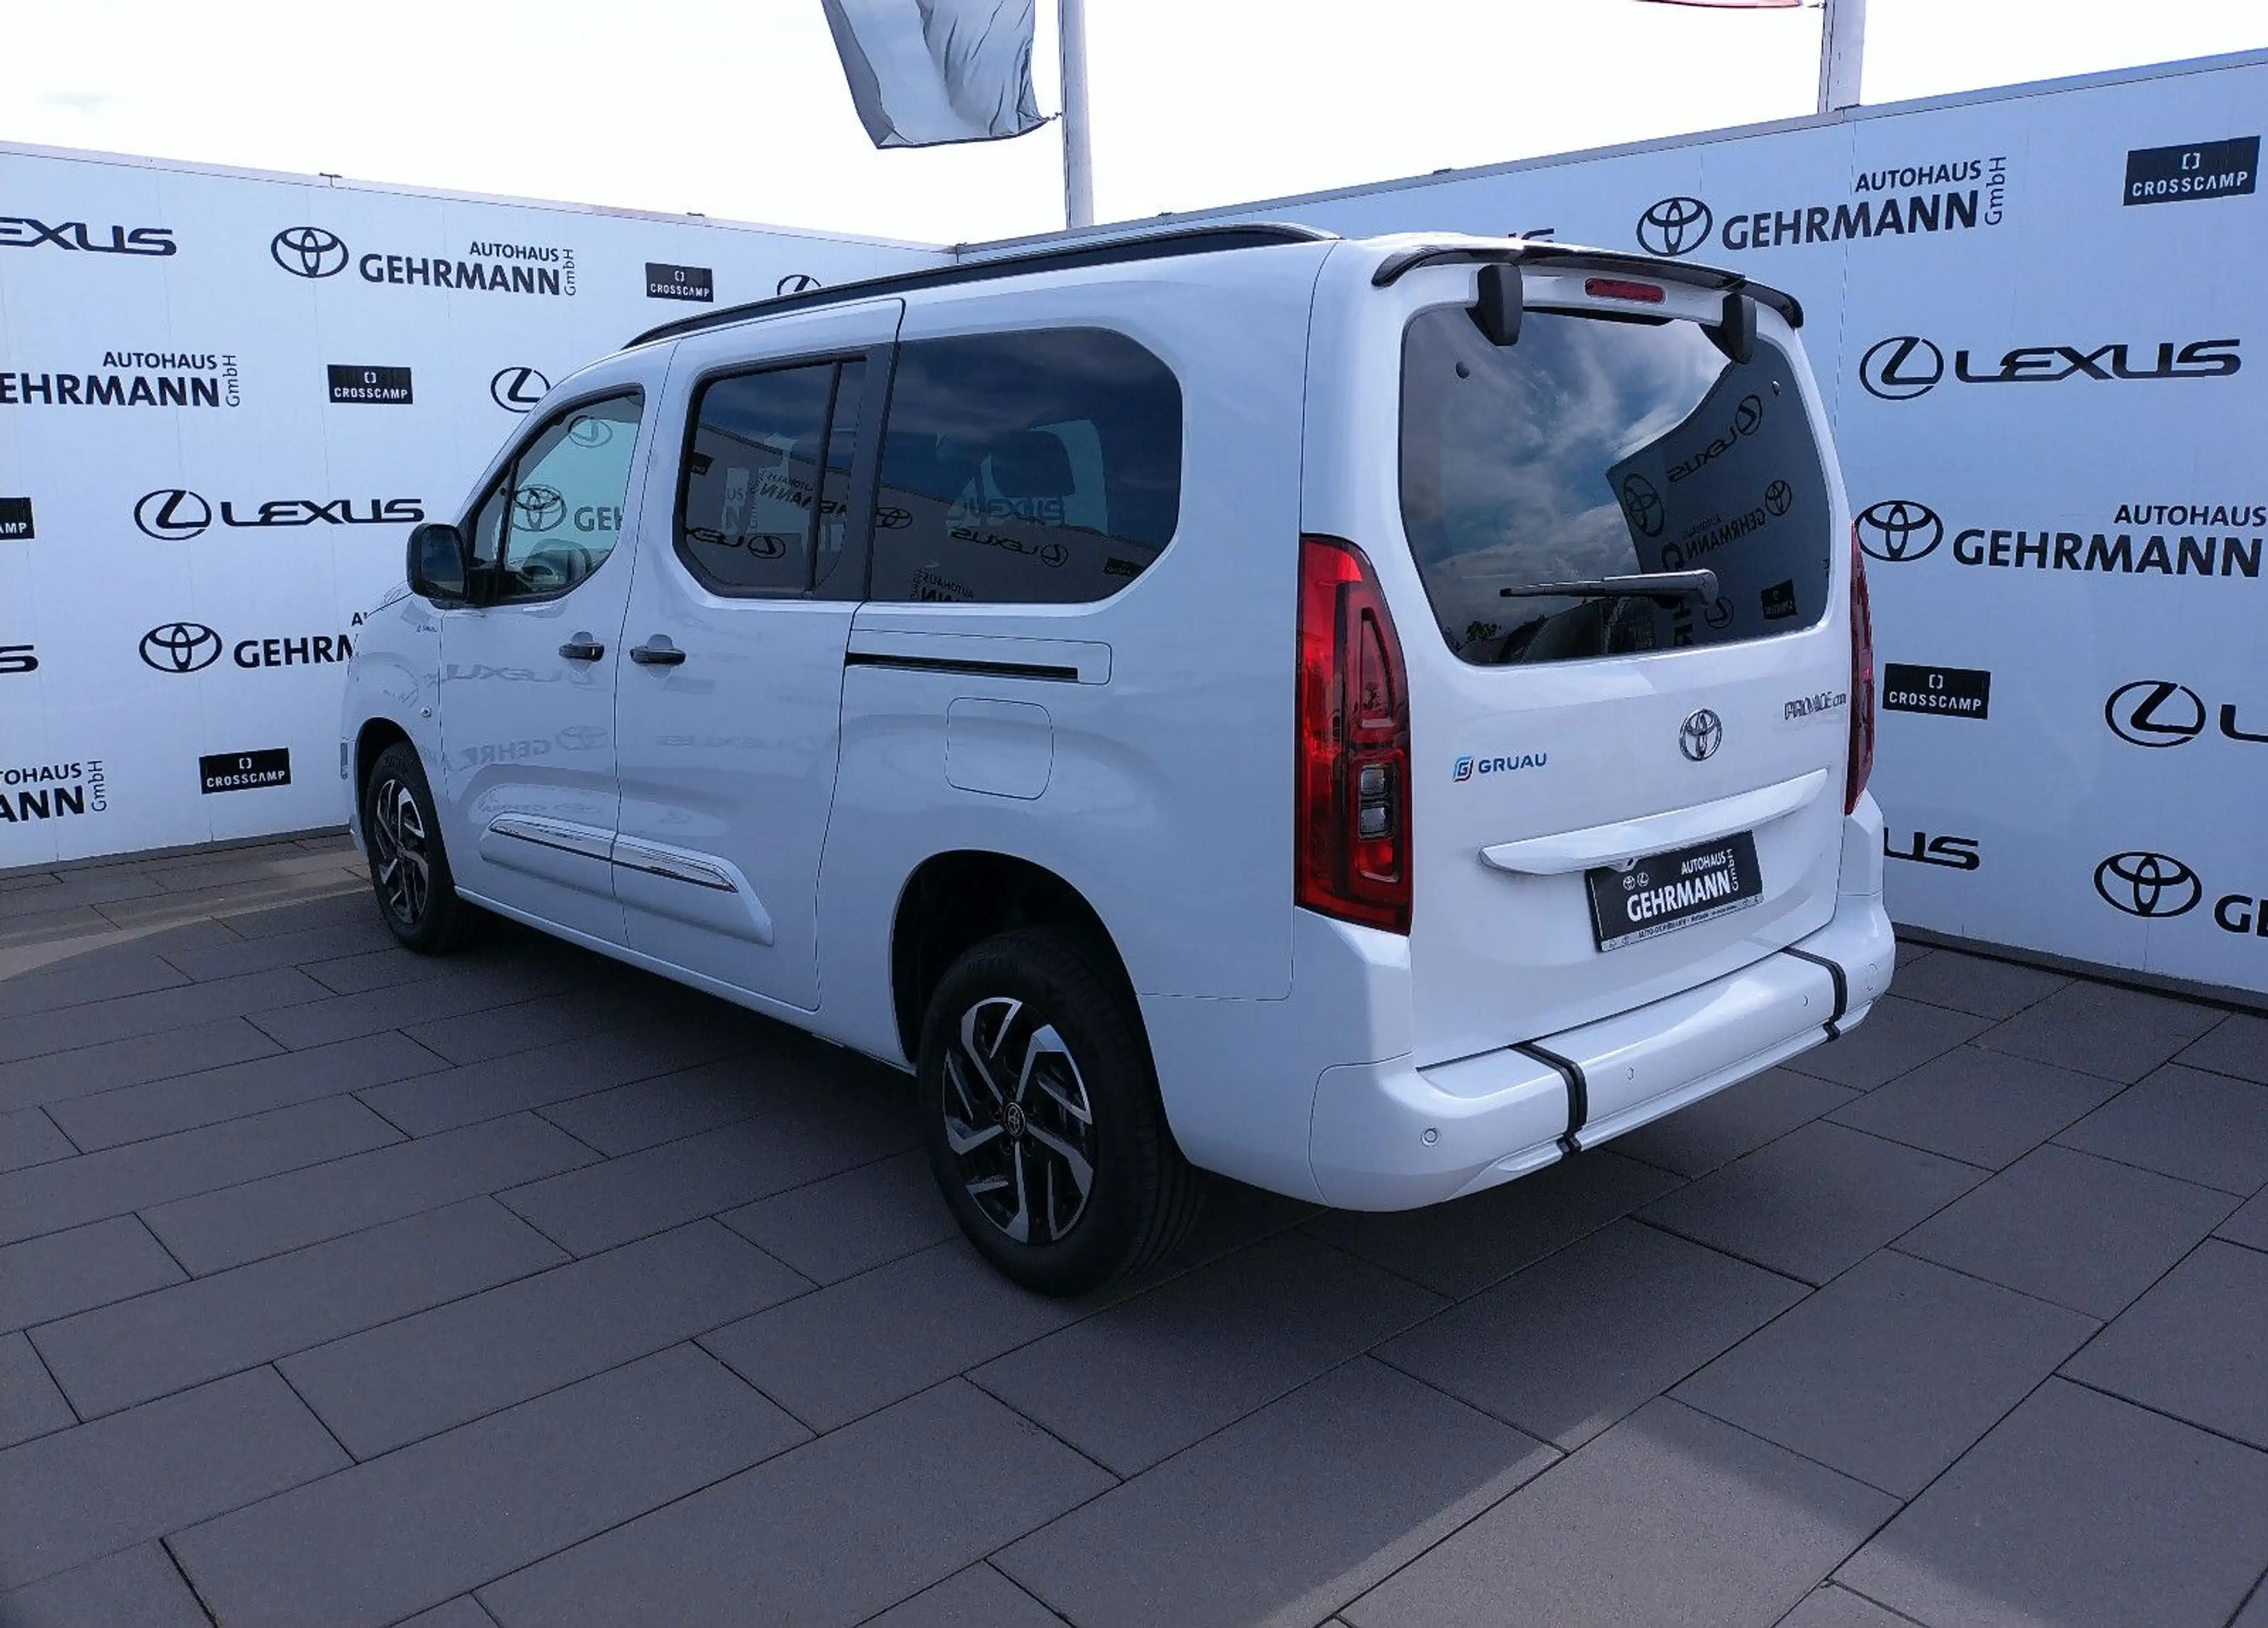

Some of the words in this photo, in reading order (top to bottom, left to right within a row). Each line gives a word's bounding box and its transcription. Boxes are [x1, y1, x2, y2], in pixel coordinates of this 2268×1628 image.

[1855, 160, 1982, 193] AUTOHAUS
[1984, 156, 2006, 225] GmbH
[2132, 171, 2248, 197] CROSSCAMP
[1722, 190, 1979, 250] GEHRMANN
[470, 241, 559, 262] AUTOHAUS
[359, 253, 560, 295] GEHRMANN
[563, 249, 576, 296] GmbH
[650, 283, 709, 297] CROSSCAMP
[102, 351, 217, 370] AUTOHAUS
[1954, 339, 2241, 383] LEXUS
[223, 354, 240, 407] GmbH
[334, 387, 408, 400] CROSSCAMP
[221, 499, 425, 527] LEXUS
[2114, 504, 2267, 527] AUTOHAUS
[1953, 529, 2262, 578] GEHRMANN
[1889, 690, 1982, 712] CROSSCAMP
[1478, 752, 1547, 774] GRUAU
[87, 760, 107, 811] GmbH
[206, 770, 285, 788] CROSSCAMP
[1681, 850, 1726, 875] AUTOHAUS
[1626, 869, 1732, 922] GEHRMANN
